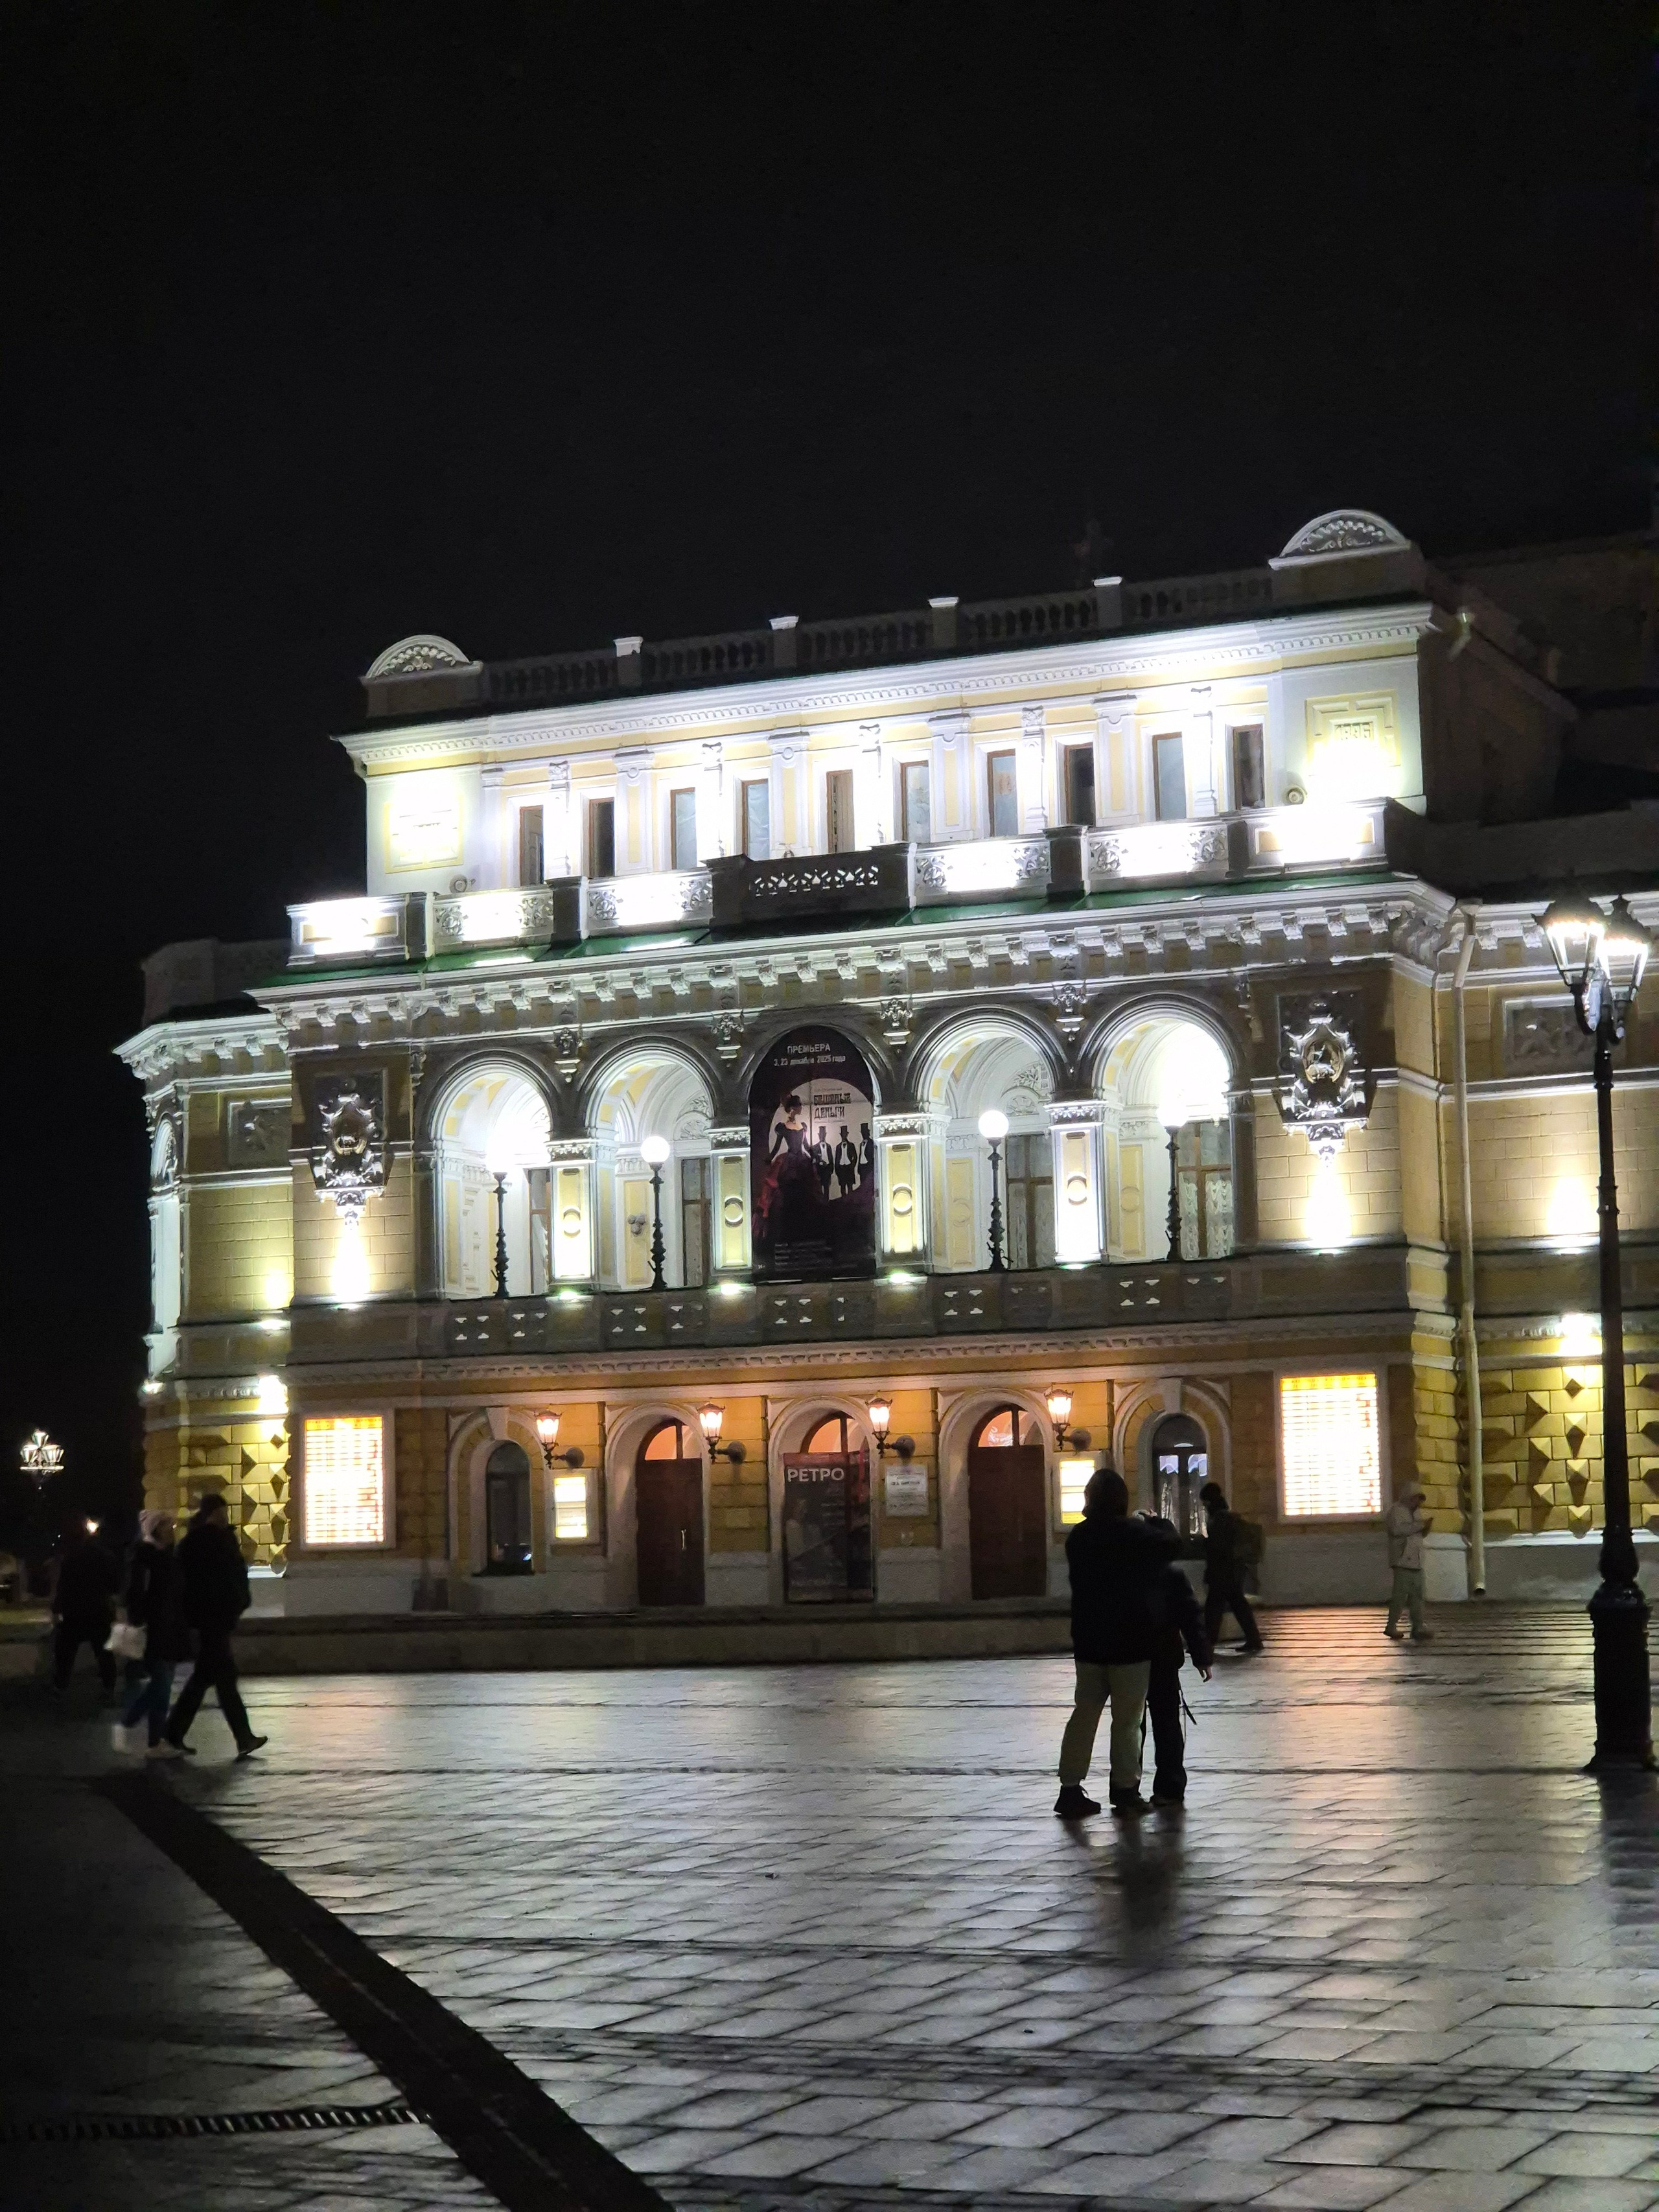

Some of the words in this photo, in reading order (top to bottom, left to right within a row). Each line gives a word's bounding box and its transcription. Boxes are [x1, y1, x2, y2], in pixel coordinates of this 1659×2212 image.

[787, 1043, 830, 1054] ПРЕМЬЕРА
[815, 1106, 844, 1120] ДЕНЬГИ
[787, 1468, 844, 1482] РЕТРО
